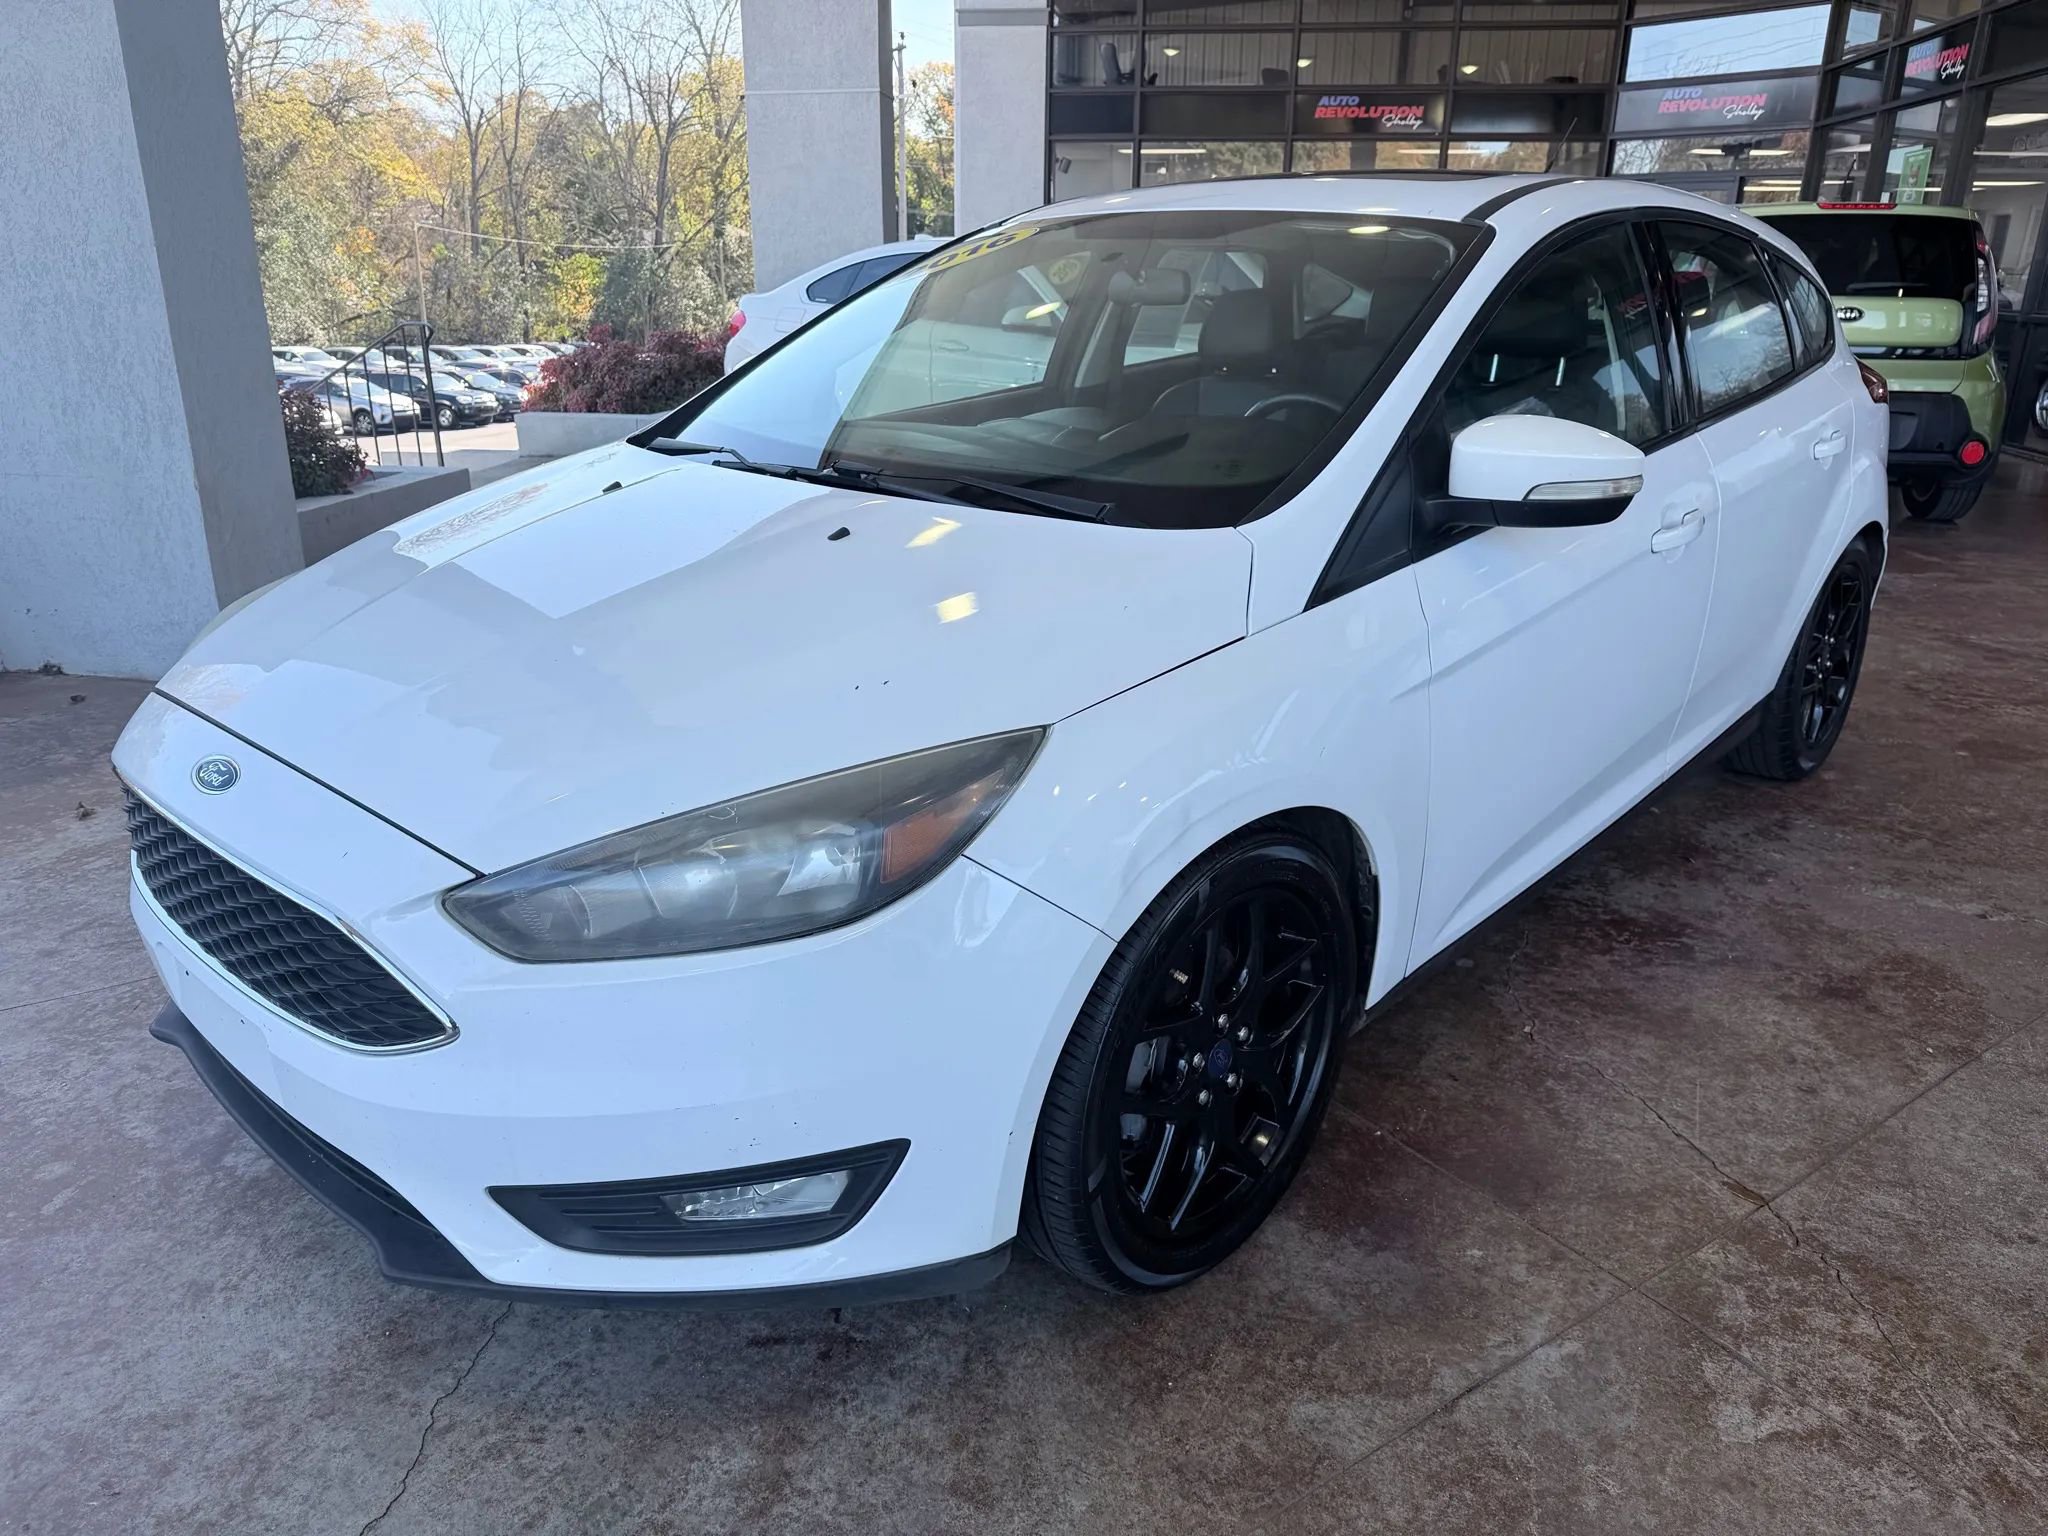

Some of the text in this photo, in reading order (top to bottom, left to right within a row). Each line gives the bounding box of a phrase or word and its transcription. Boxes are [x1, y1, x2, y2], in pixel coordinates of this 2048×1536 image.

[1318, 95, 1360, 106] AUTO
[1663, 88, 1702, 100] AUTO
[1657, 93, 1768, 113] REVOLUTION
[1314, 105, 1425, 118] REVOLUTION
[1381, 113, 1423, 130] Shelby
[920, 232, 1020, 270] 016
[1836, 309, 1860, 319] KIA
[199, 761, 229, 787] Ford
